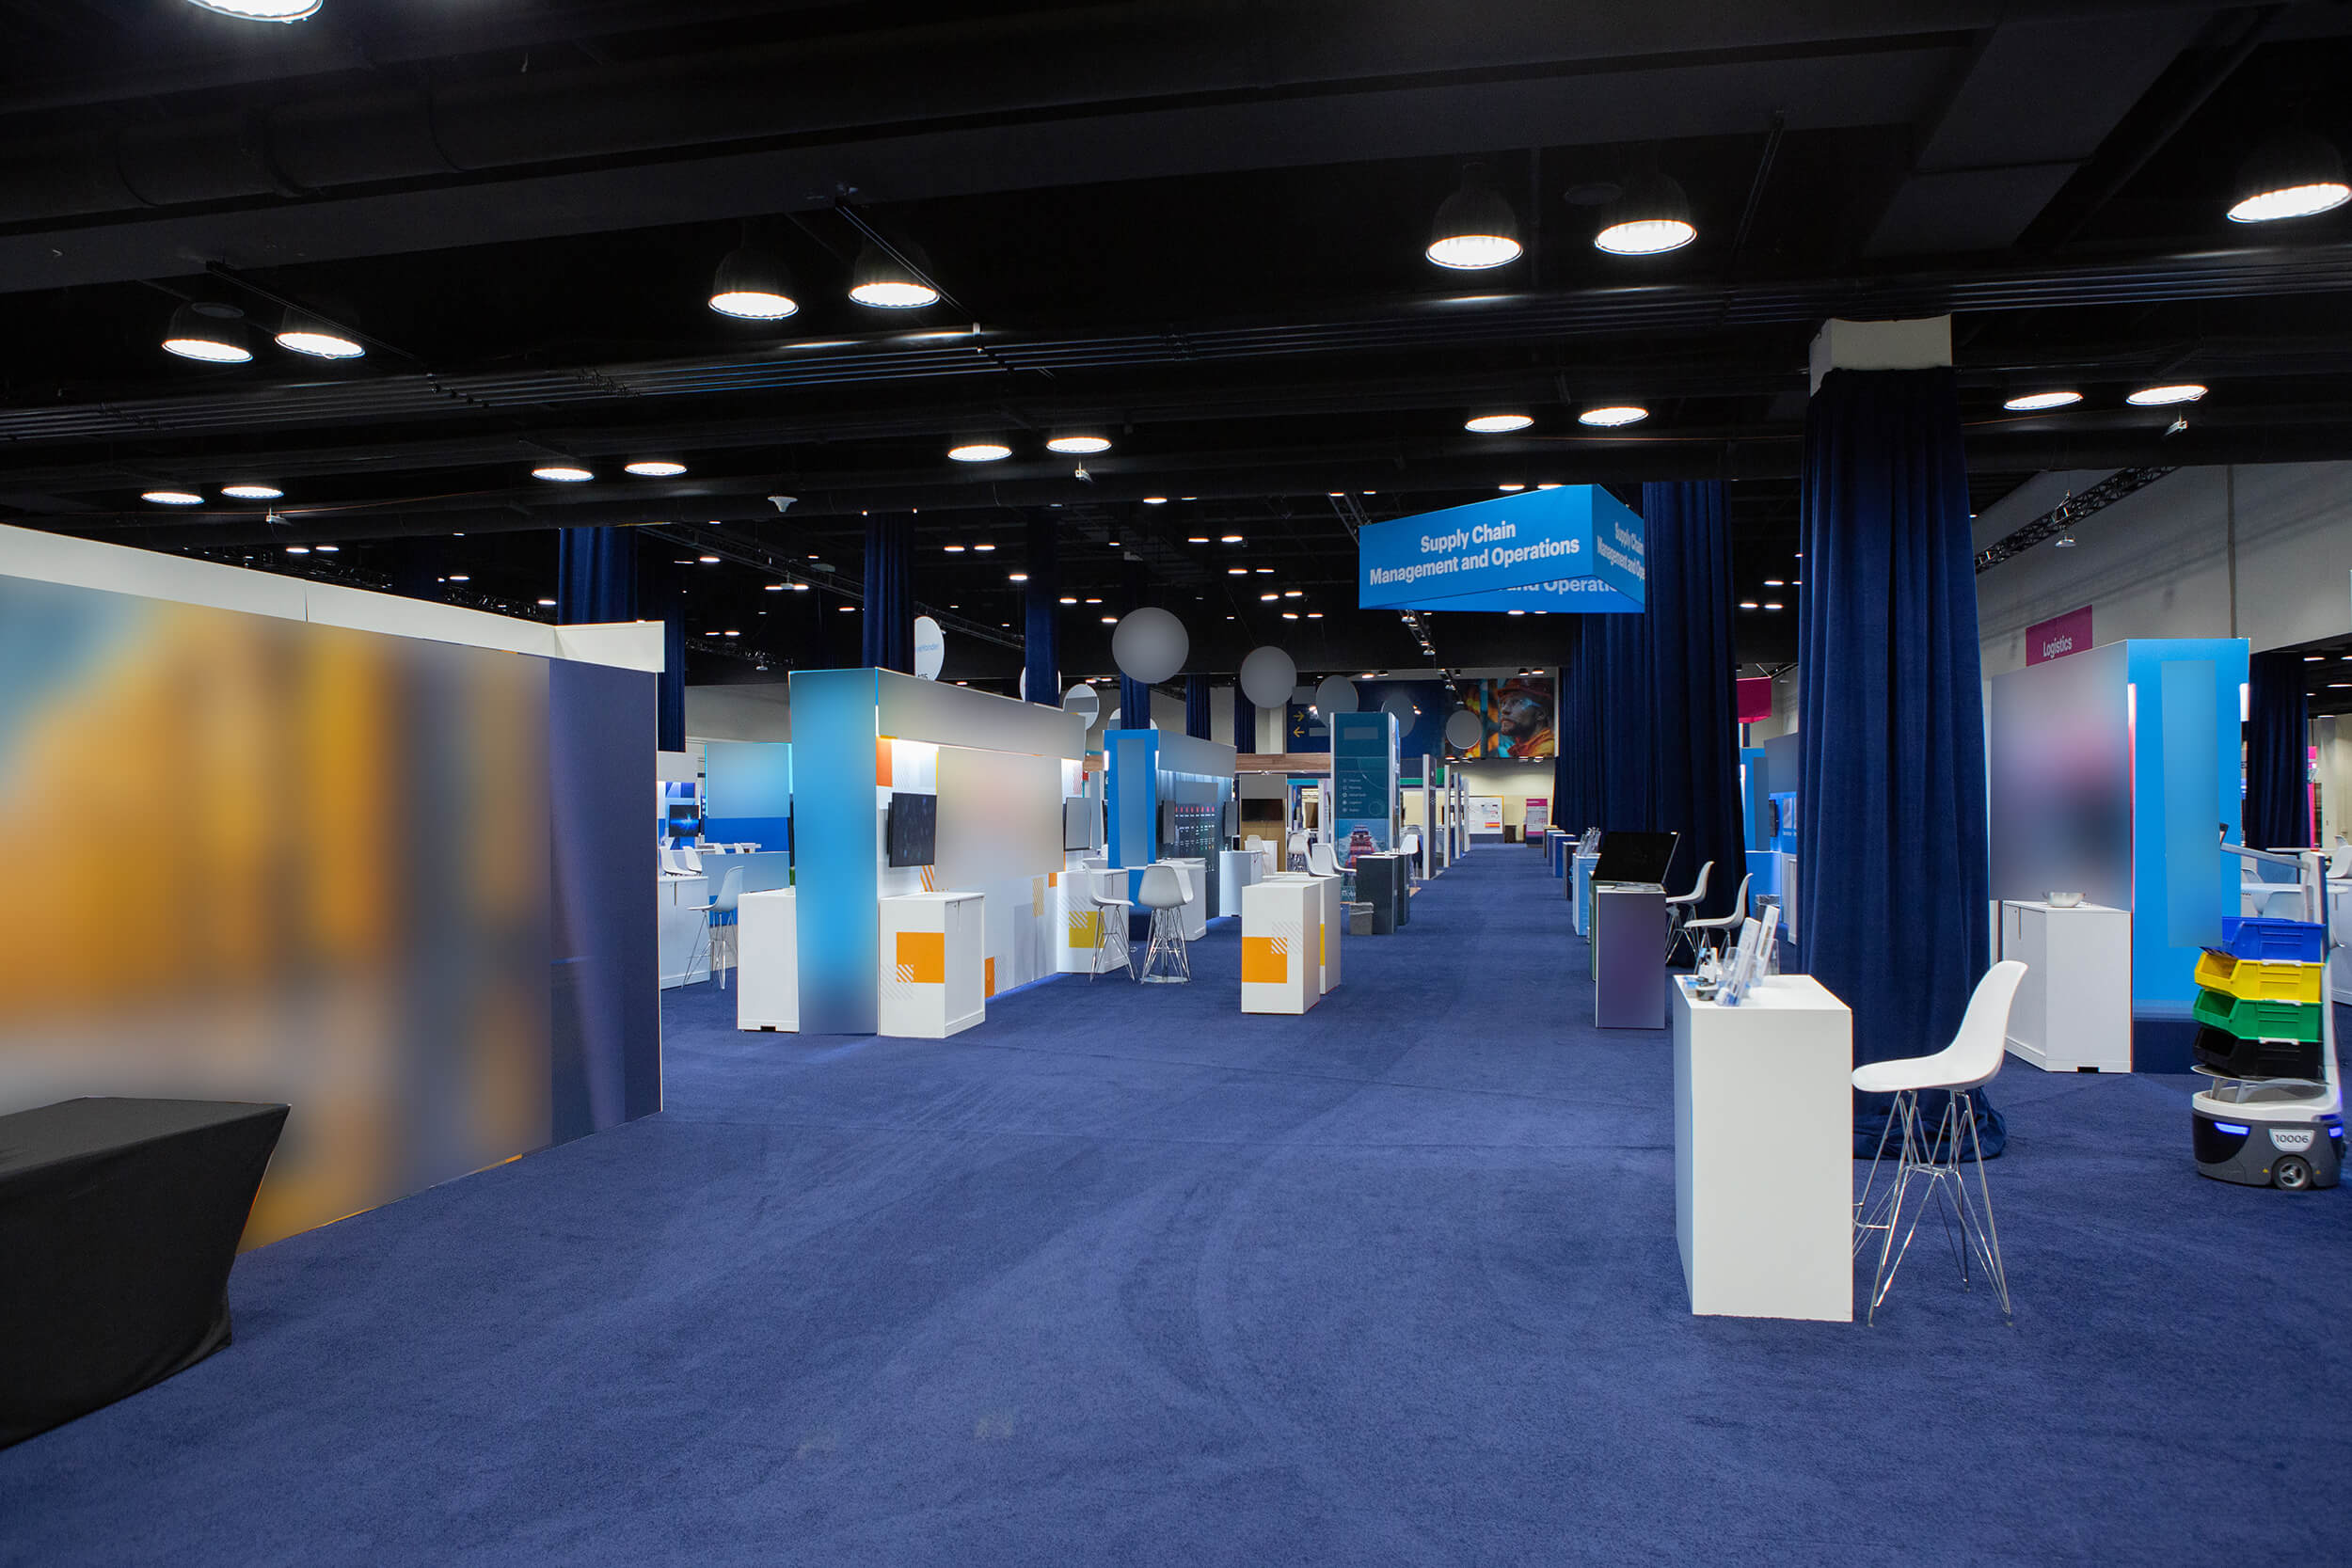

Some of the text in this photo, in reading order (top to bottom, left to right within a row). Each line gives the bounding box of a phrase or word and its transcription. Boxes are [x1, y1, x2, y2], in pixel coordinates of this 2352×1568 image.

[1421, 520, 1516, 553] Supply Chain
[1615, 522, 1631, 551] Supply
[1370, 538, 1580, 585] Management and Operations
[2042, 635, 2073, 658] Logistics
[2275, 1134, 2309, 1143] 10006
